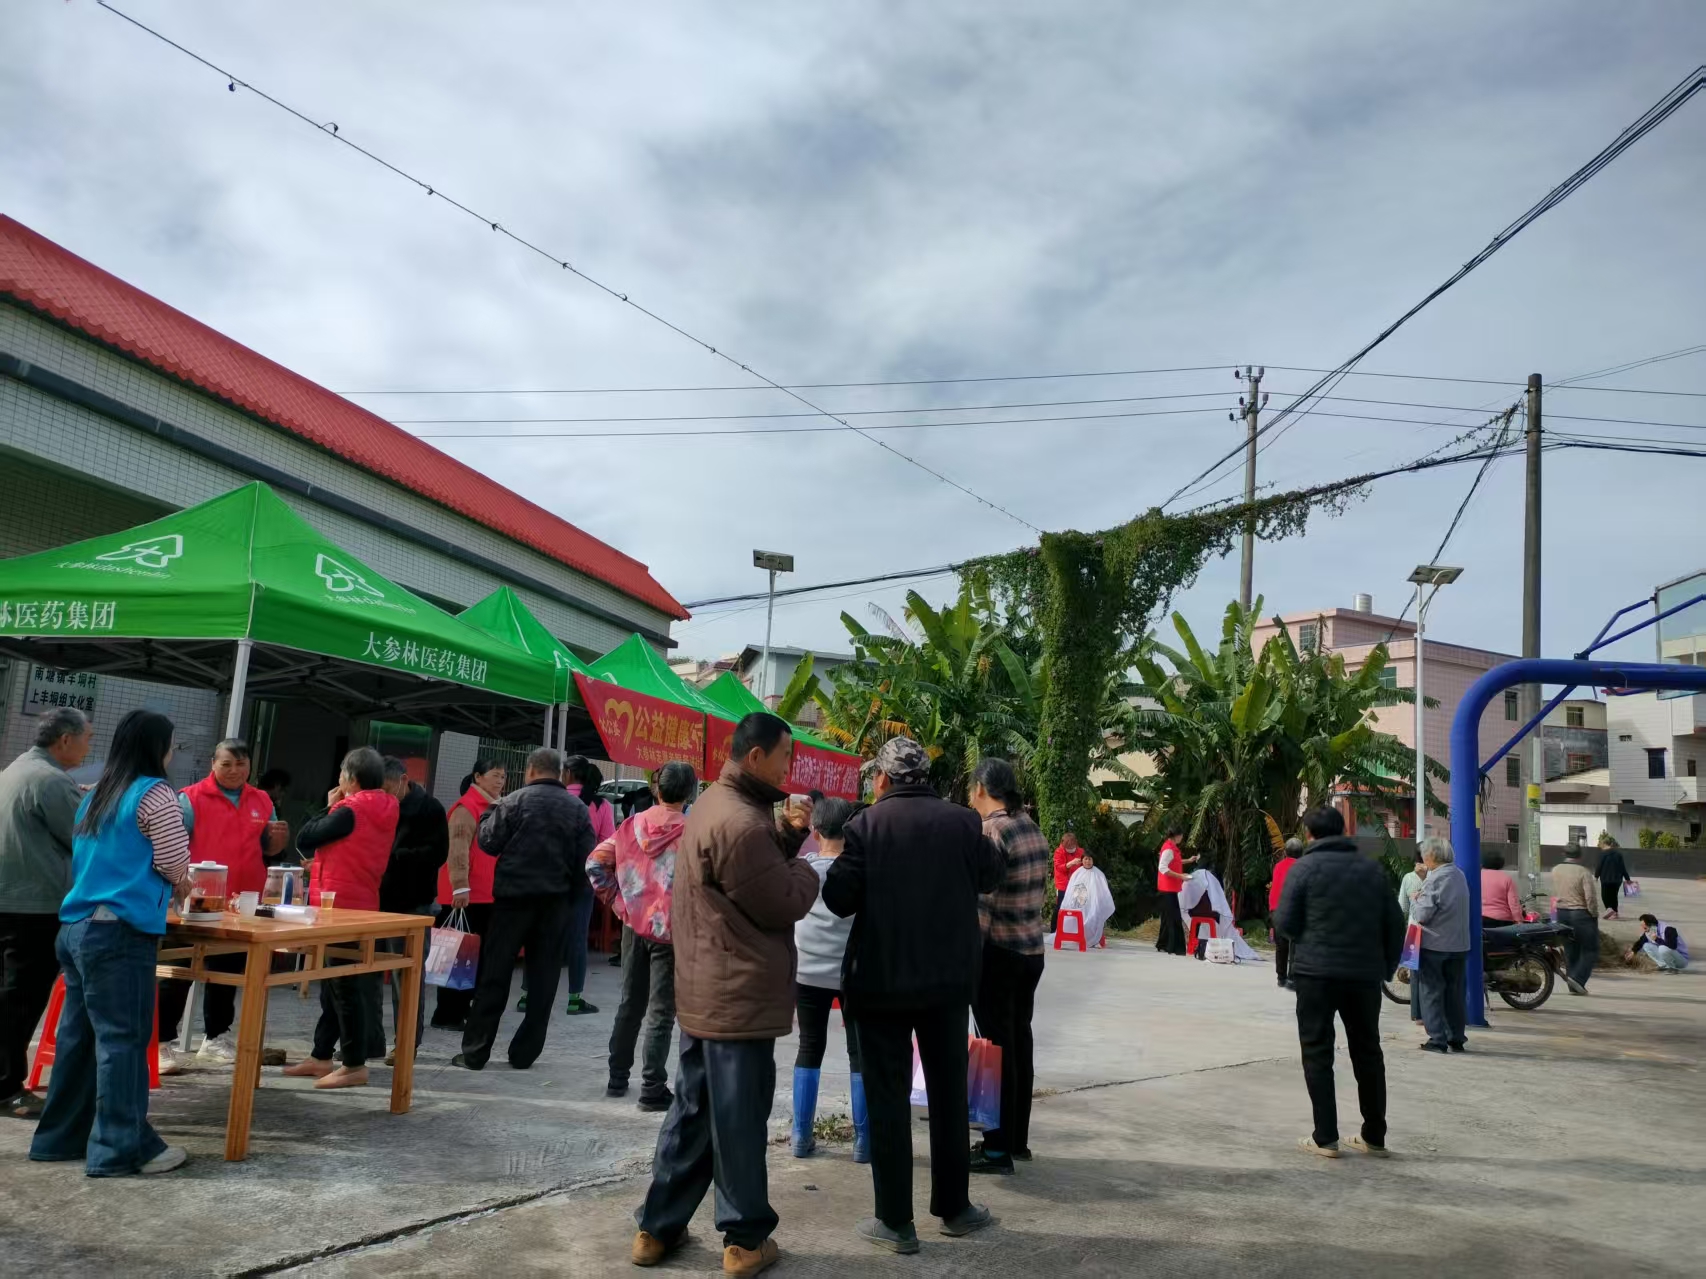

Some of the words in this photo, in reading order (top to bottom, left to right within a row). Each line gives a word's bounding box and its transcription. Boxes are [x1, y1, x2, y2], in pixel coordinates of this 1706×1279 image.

[361, 631, 488, 684] 大参林医药集团
